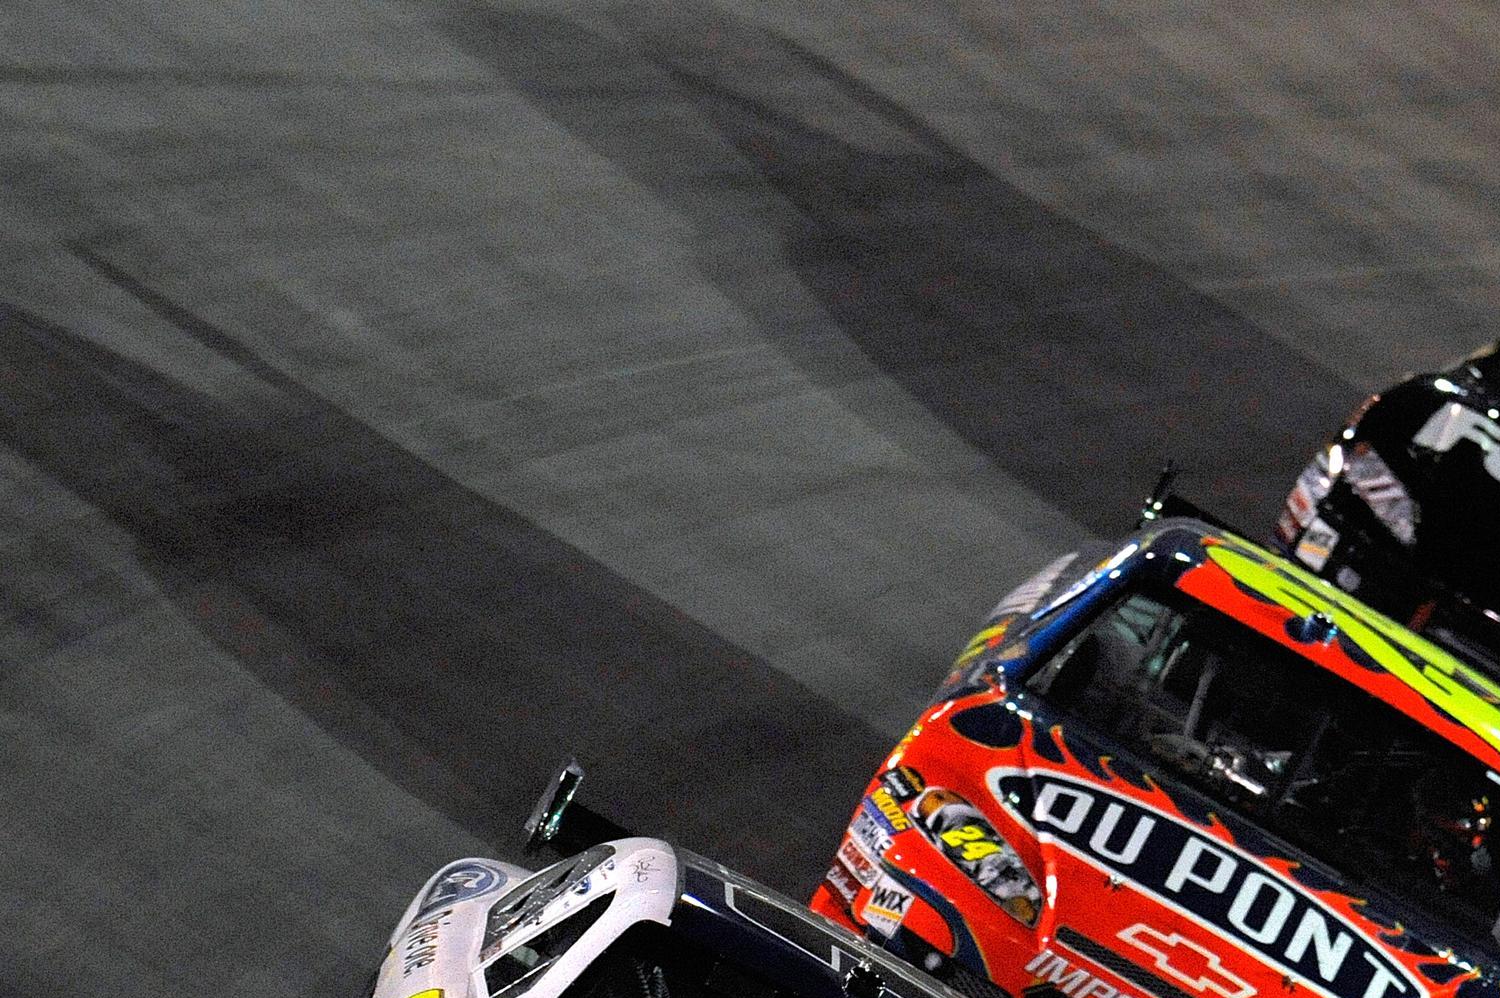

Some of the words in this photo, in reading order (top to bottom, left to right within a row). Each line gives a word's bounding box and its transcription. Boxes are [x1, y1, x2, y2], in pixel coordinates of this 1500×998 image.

[1033, 783, 1155, 866] DU
[940, 825, 1002, 861] 24
[873, 886, 908, 912] WIX
